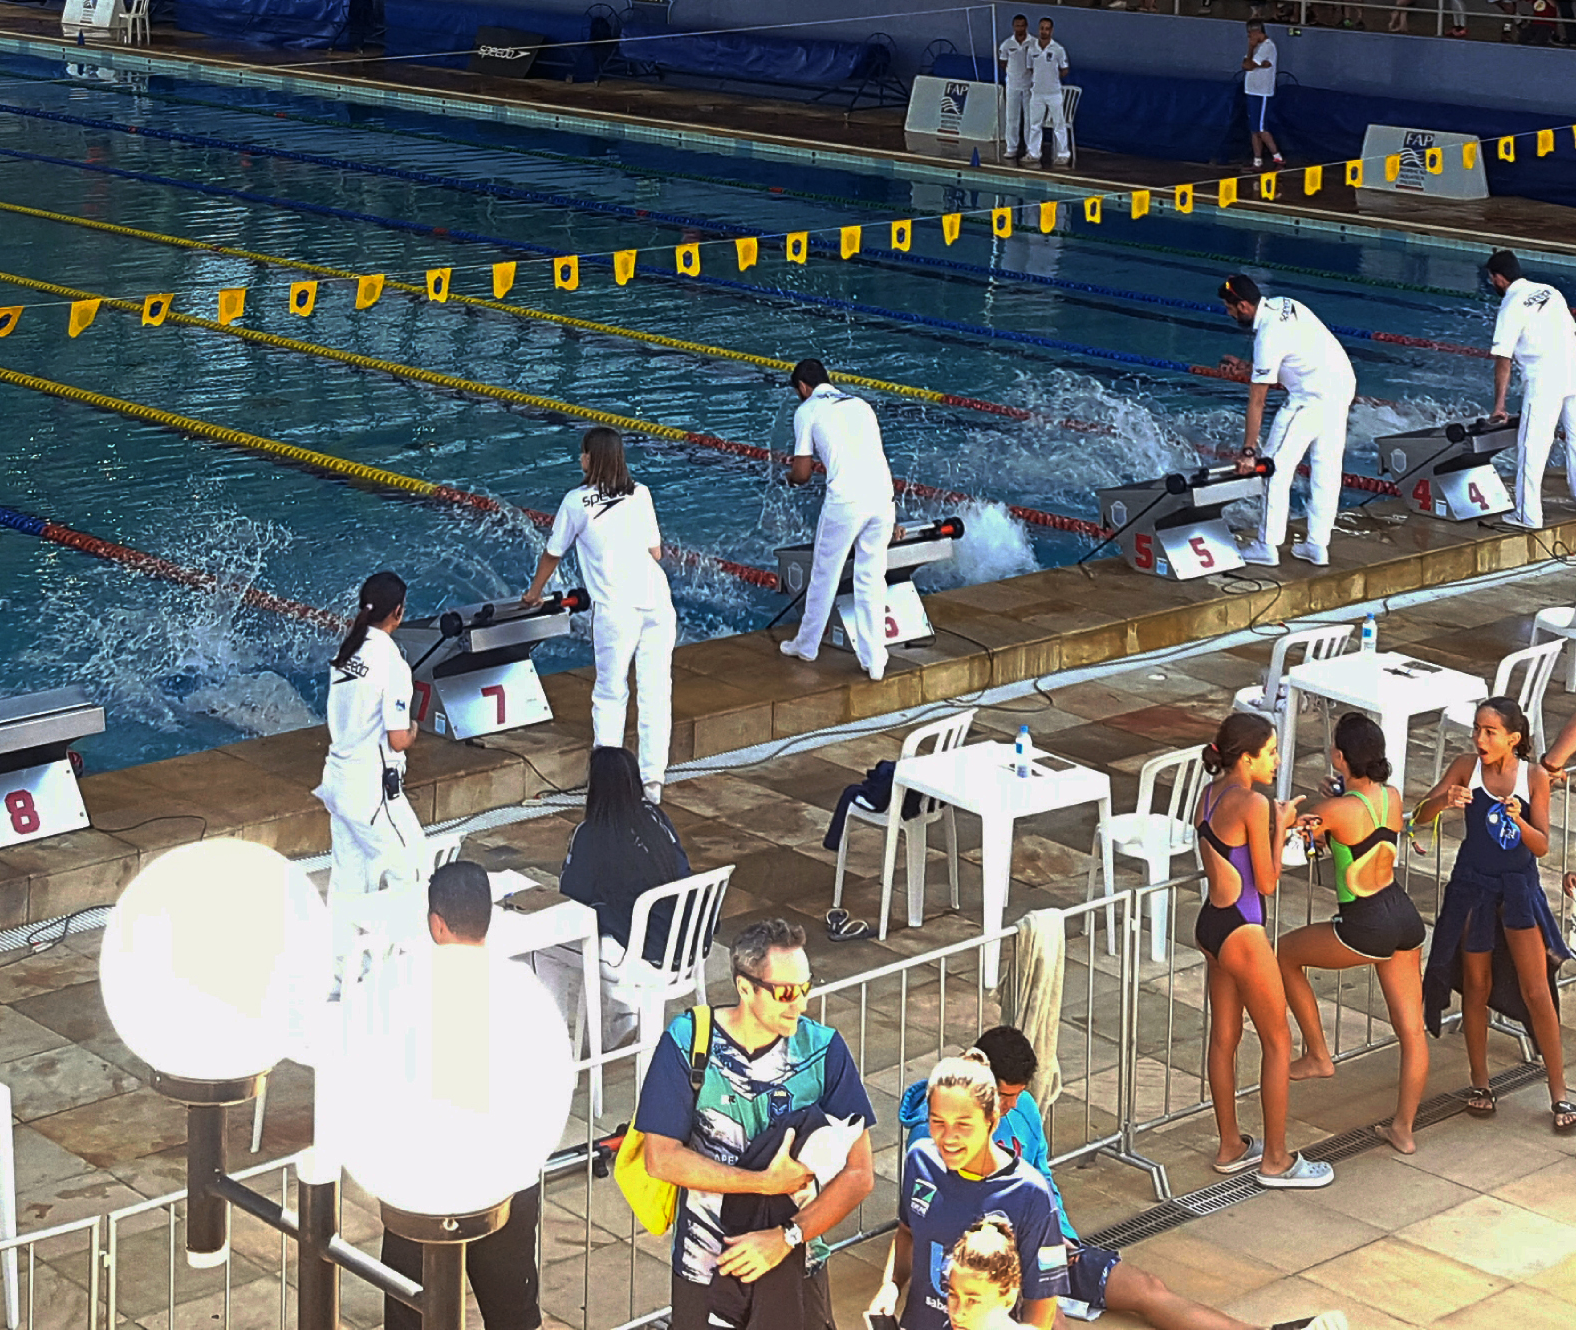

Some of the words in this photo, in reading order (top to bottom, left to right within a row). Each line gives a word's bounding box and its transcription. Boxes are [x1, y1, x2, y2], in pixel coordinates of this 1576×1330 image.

[946, 82, 969, 96] FAP
[1406, 132, 1434, 147] FAP
[1412, 479, 1432, 511] 4
[1467, 481, 1491, 511] 4
[1134, 534, 1154, 569] 5
[1188, 537, 1216, 569] 5
[414, 680, 432, 722] 7
[481, 684, 506, 725] 7
[4, 788, 41, 835] 8
